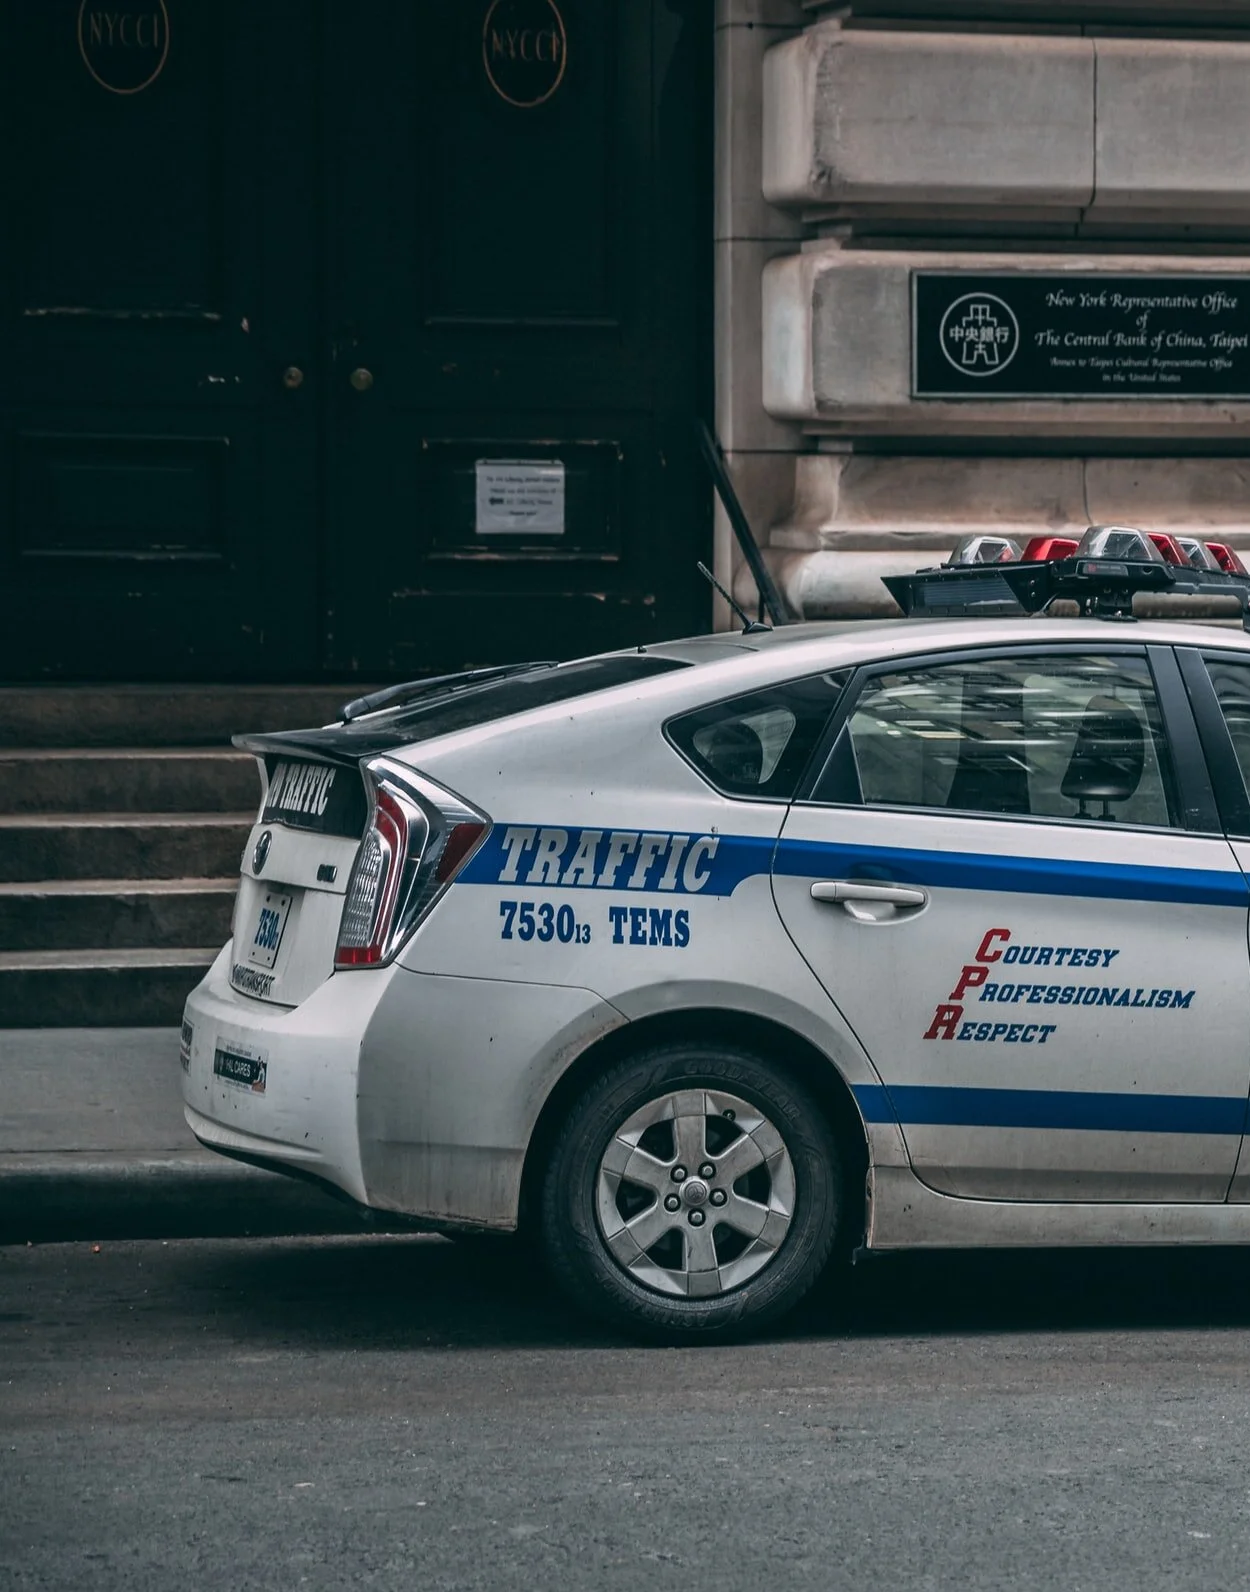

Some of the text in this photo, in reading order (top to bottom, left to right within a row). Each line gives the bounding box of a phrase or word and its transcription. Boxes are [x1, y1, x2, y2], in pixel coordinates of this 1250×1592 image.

[1045, 289, 1237, 315] New York Representative Office
[949, 324, 1009, 343] 中央銀行
[1136, 309, 1151, 333] of
[1034, 329, 1248, 354] The Central Bank of China, Taipei
[279, 764, 337, 816] TRAFFIC
[498, 827, 719, 892] TRAFFIC
[609, 906, 690, 947] TEMS
